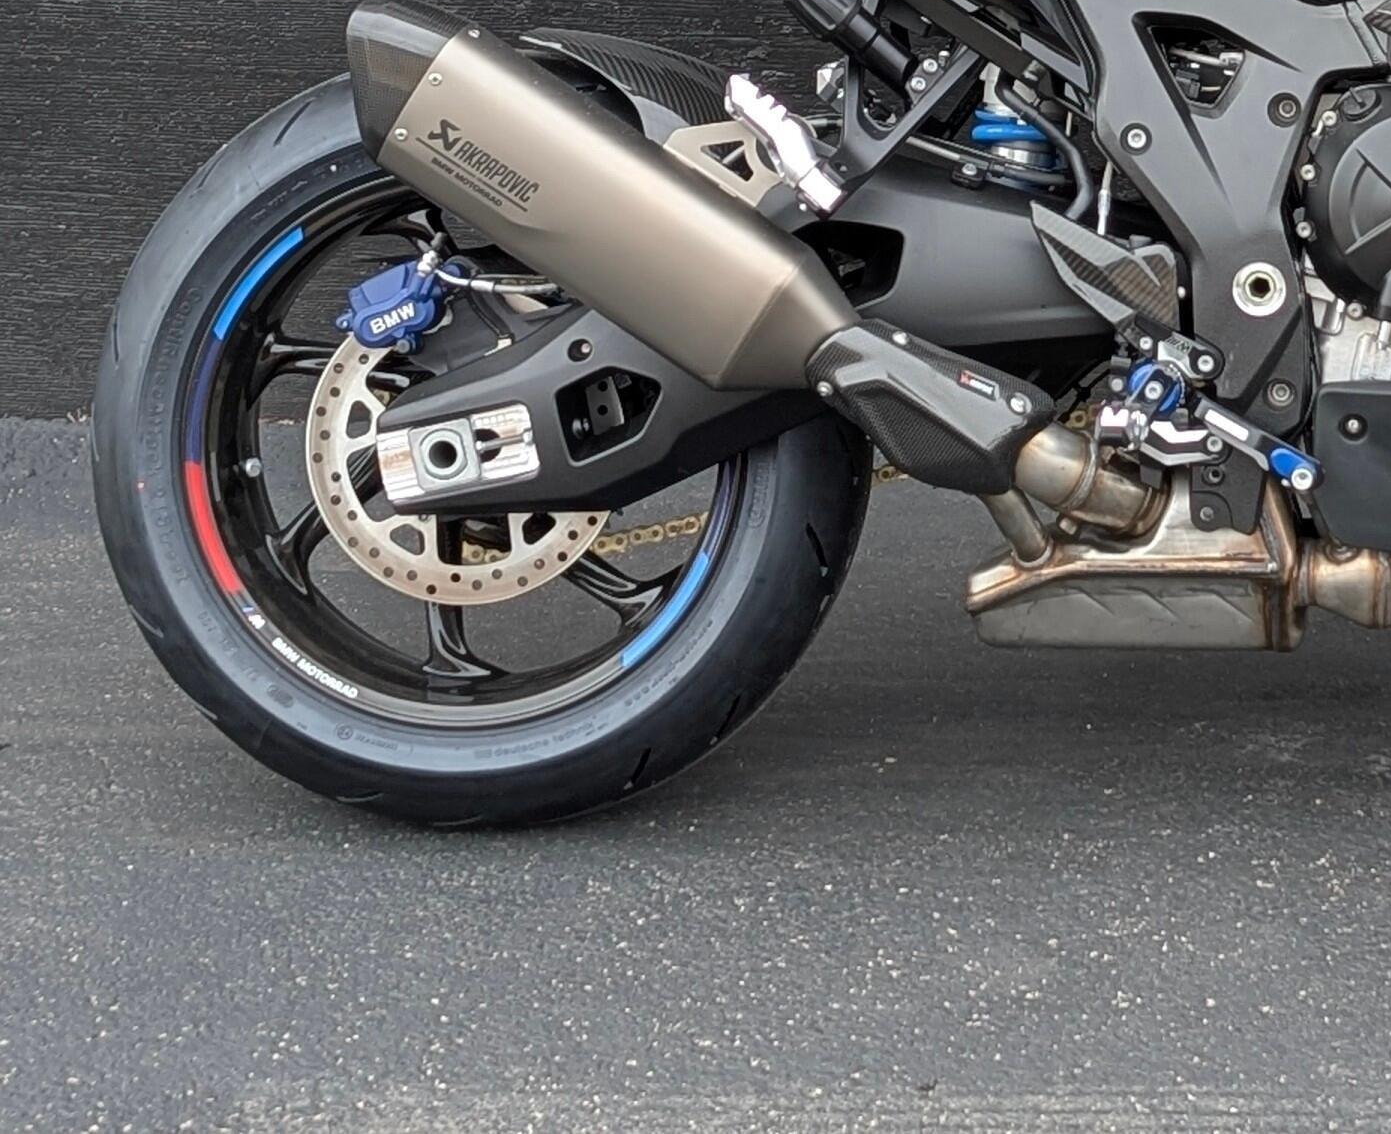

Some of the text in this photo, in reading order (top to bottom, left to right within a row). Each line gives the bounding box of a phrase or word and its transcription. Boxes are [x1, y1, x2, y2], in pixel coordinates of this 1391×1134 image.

[431, 156, 454, 175] BMW
[370, 302, 416, 334] BMW
[272, 637, 300, 662] BMW
[296, 658, 359, 698] MOTORRAD
